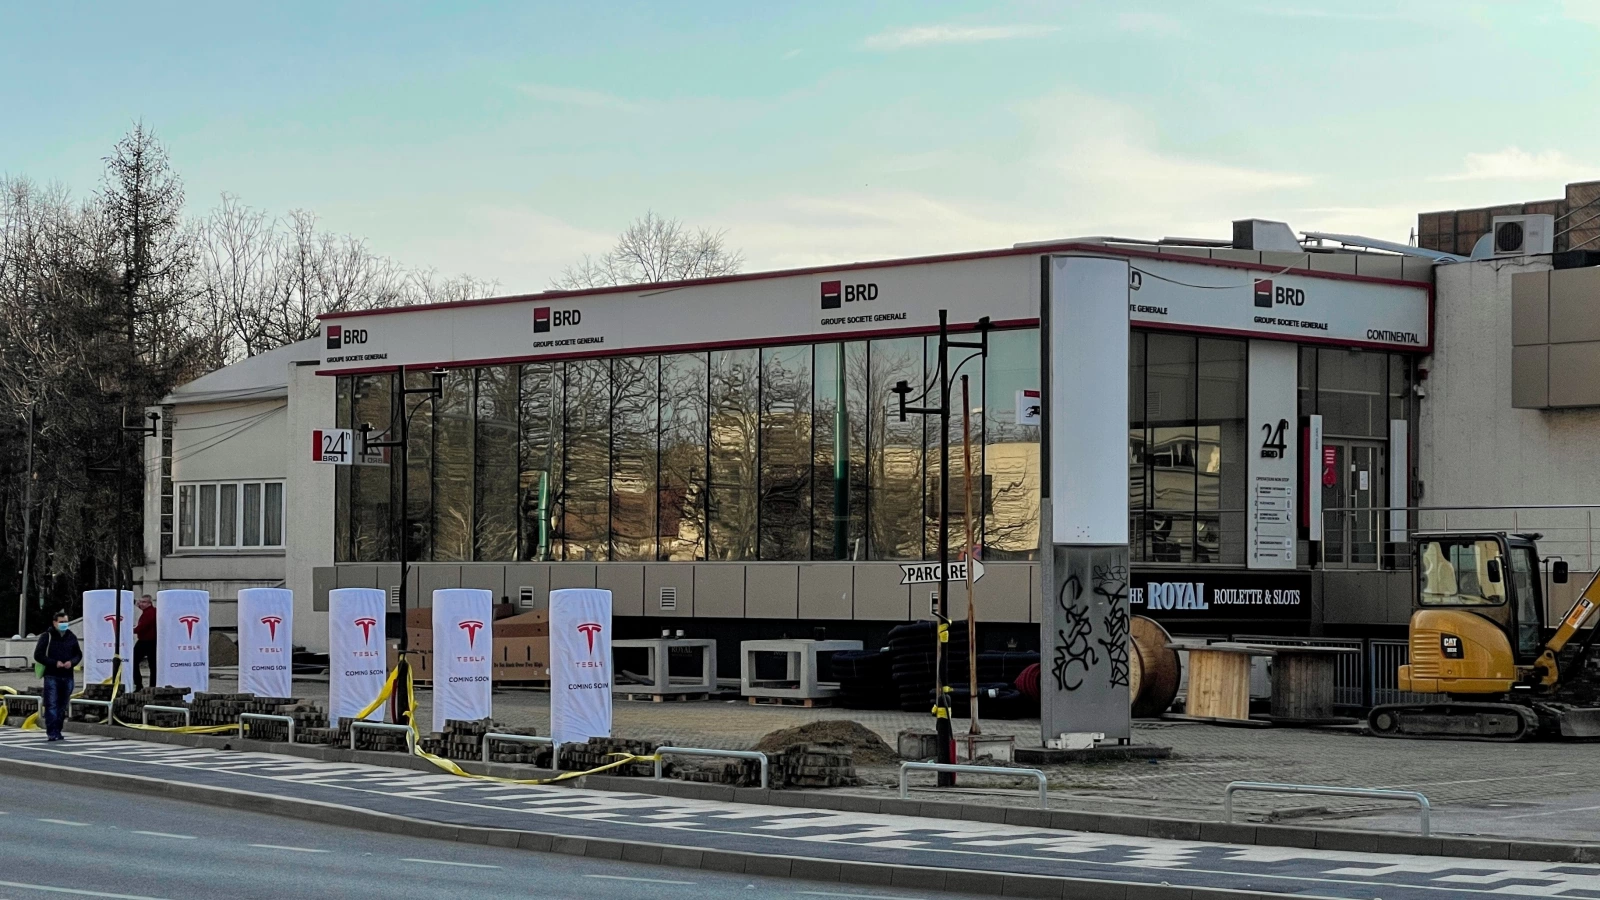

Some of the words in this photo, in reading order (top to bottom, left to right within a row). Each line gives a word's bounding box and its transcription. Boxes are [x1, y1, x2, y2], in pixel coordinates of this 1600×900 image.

[845, 283, 878, 302] BRD
[1275, 286, 1305, 306] BRD
[1137, 304, 1168, 315] GENERALE
[553, 309, 581, 327] BRD
[821, 317, 846, 325] GROUPE
[847, 315, 872, 324] SOCIETE
[874, 312, 907, 321] GENERALE
[1254, 316, 1276, 325] GROUPE
[1277, 318, 1299, 327] SOCIETE
[1300, 321, 1328, 330] GENERALE
[344, 329, 368, 344] BRD
[555, 338, 576, 346] SOCIETE
[577, 336, 604, 344] GENERALE
[1366, 329, 1420, 344] CONTINENTAL
[1261, 449, 1278, 458] BRD
[907, 564, 967, 582] PARCRE
[1130, 588, 1144, 603] HE
[1147, 582, 1209, 610] ROYAL
[1213, 589, 1263, 605] ROULETTE
[1264, 589, 1272, 605] &
[1273, 589, 1300, 605] SLOTS
[1443, 637, 1457, 646] CAT
